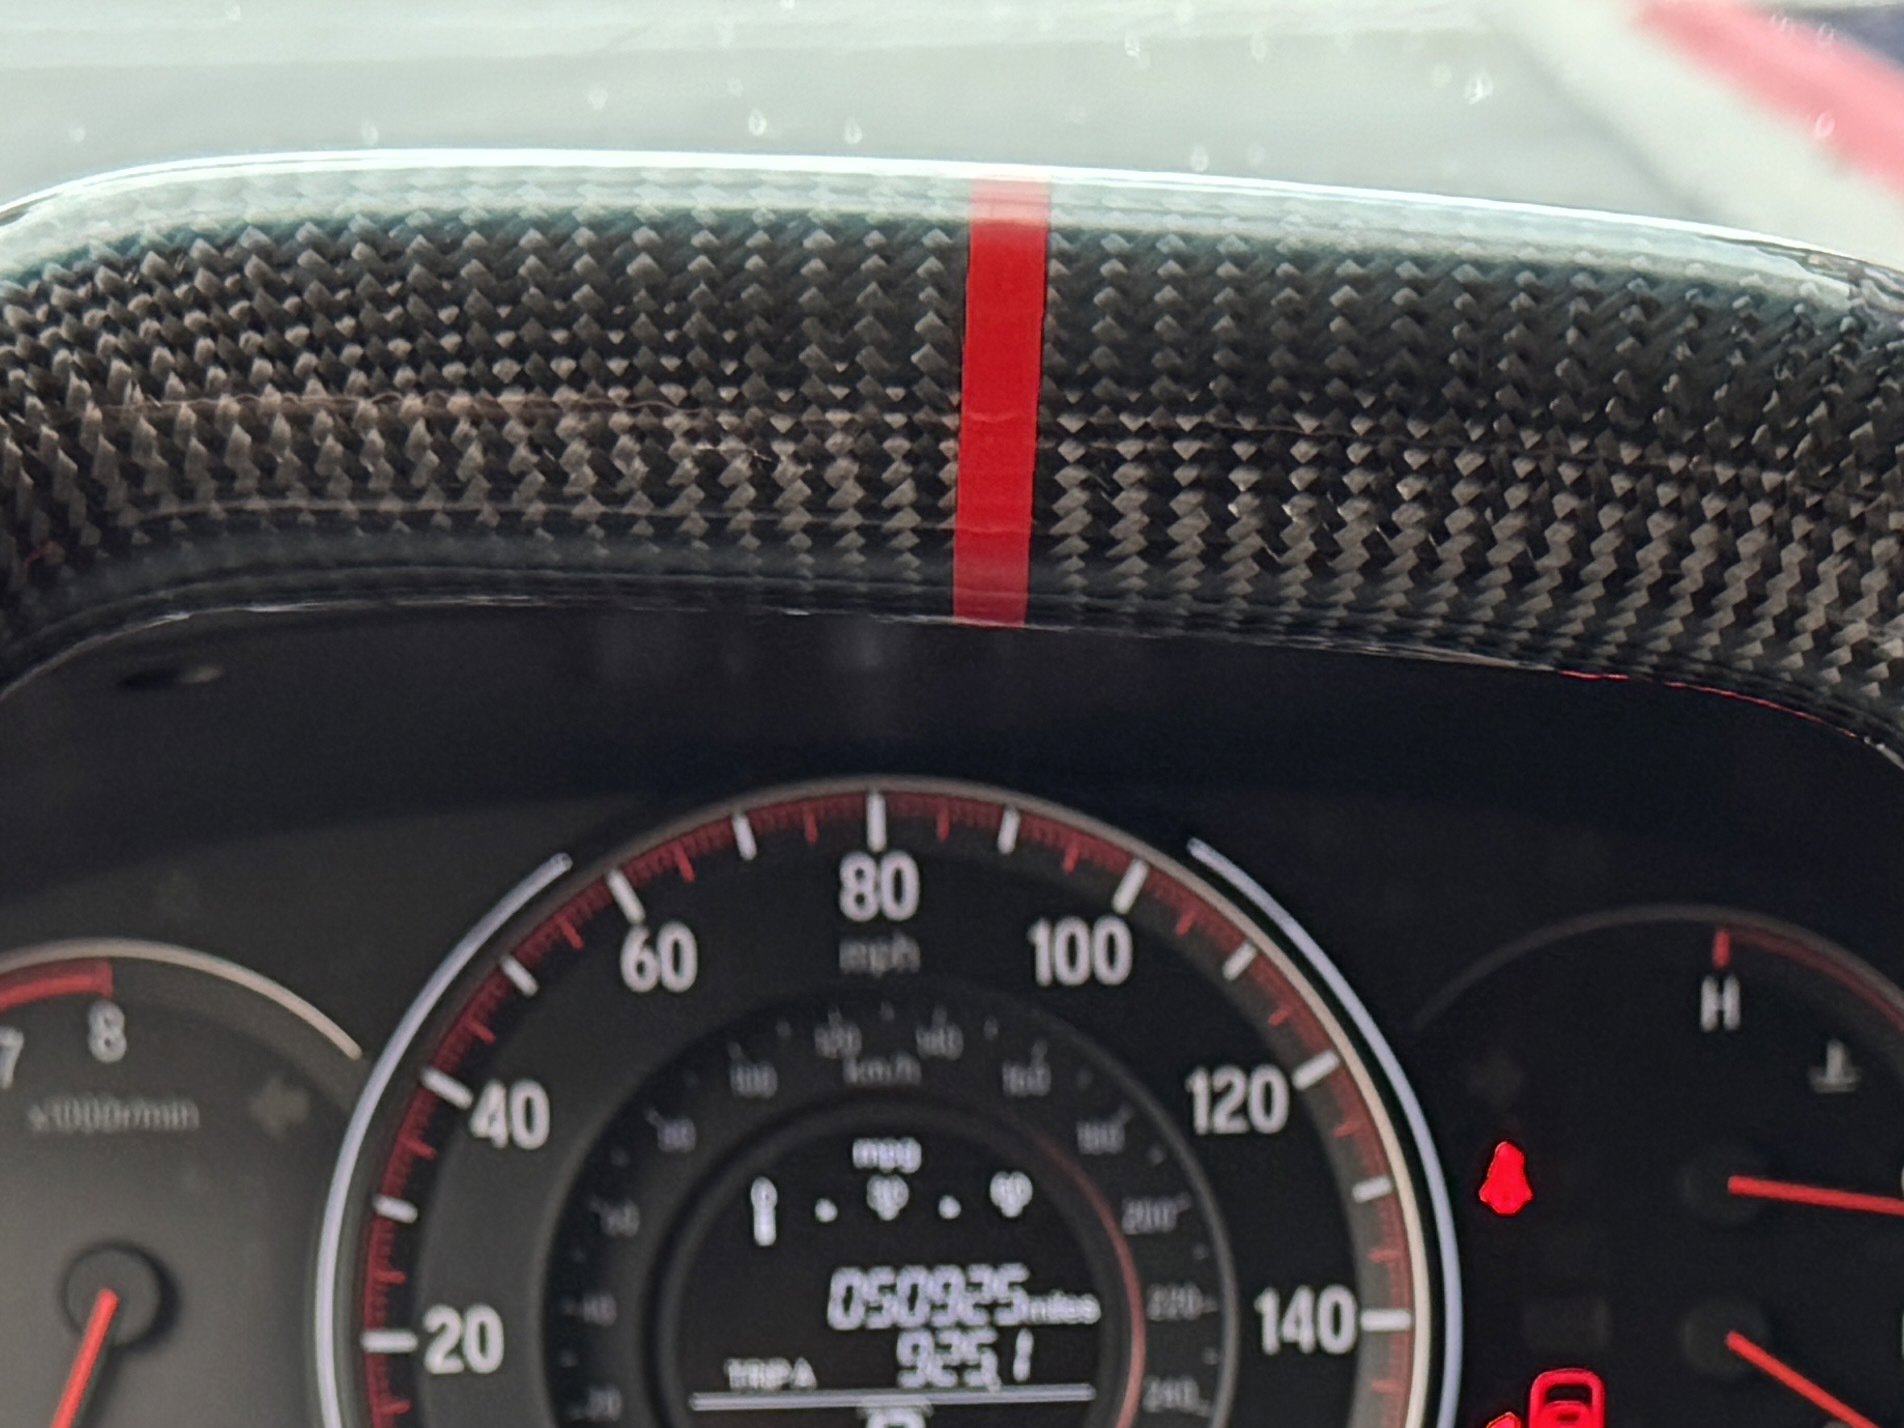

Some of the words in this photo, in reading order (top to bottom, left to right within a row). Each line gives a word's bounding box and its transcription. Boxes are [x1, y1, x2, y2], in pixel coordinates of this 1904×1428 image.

[840, 850, 920, 921] 80
[621, 921, 698, 992] 60
[1030, 916, 1132, 986] 100
[88, 1002, 127, 1063] 8
[1700, 976, 1741, 1031] H
[469, 1080, 550, 1150] 40
[1186, 1064, 1289, 1134] 120
[423, 1304, 505, 1374] 20
[1255, 1284, 1358, 1354] 140
